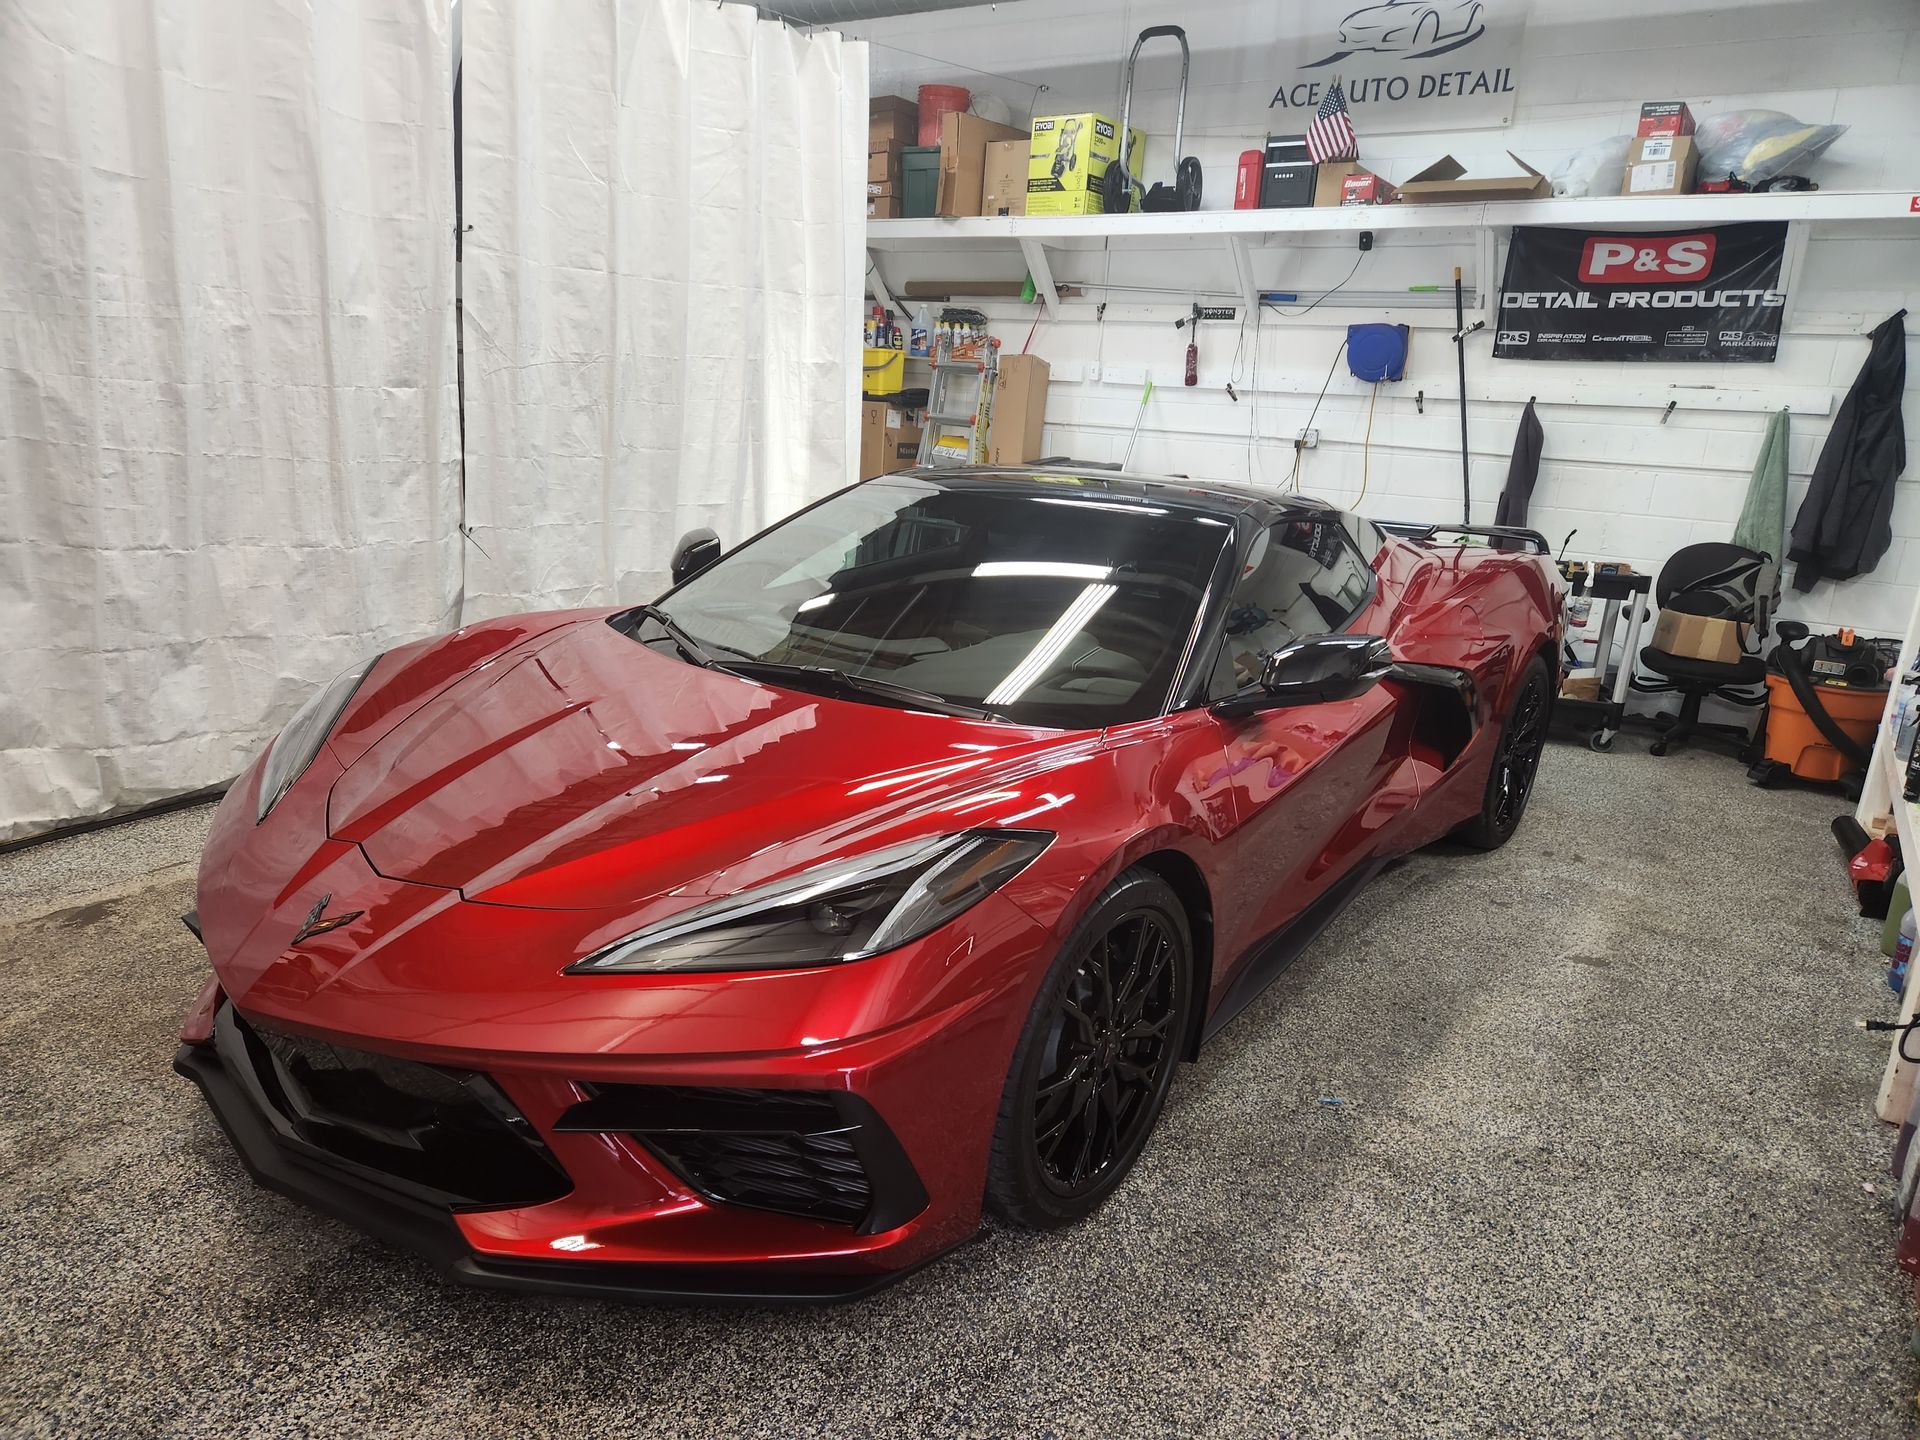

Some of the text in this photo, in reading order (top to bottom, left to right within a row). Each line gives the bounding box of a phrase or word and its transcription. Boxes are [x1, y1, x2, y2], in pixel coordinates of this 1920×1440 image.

[1268, 68, 1515, 108] ACE UTO DETAIL
[1035, 121, 1054, 130] RYOBI
[1096, 120, 1113, 138] RYOBI
[1588, 240, 1707, 275] P&S
[1501, 289, 1786, 309] DETAIL PRODUCTS
[1499, 333, 1528, 343] P&S
